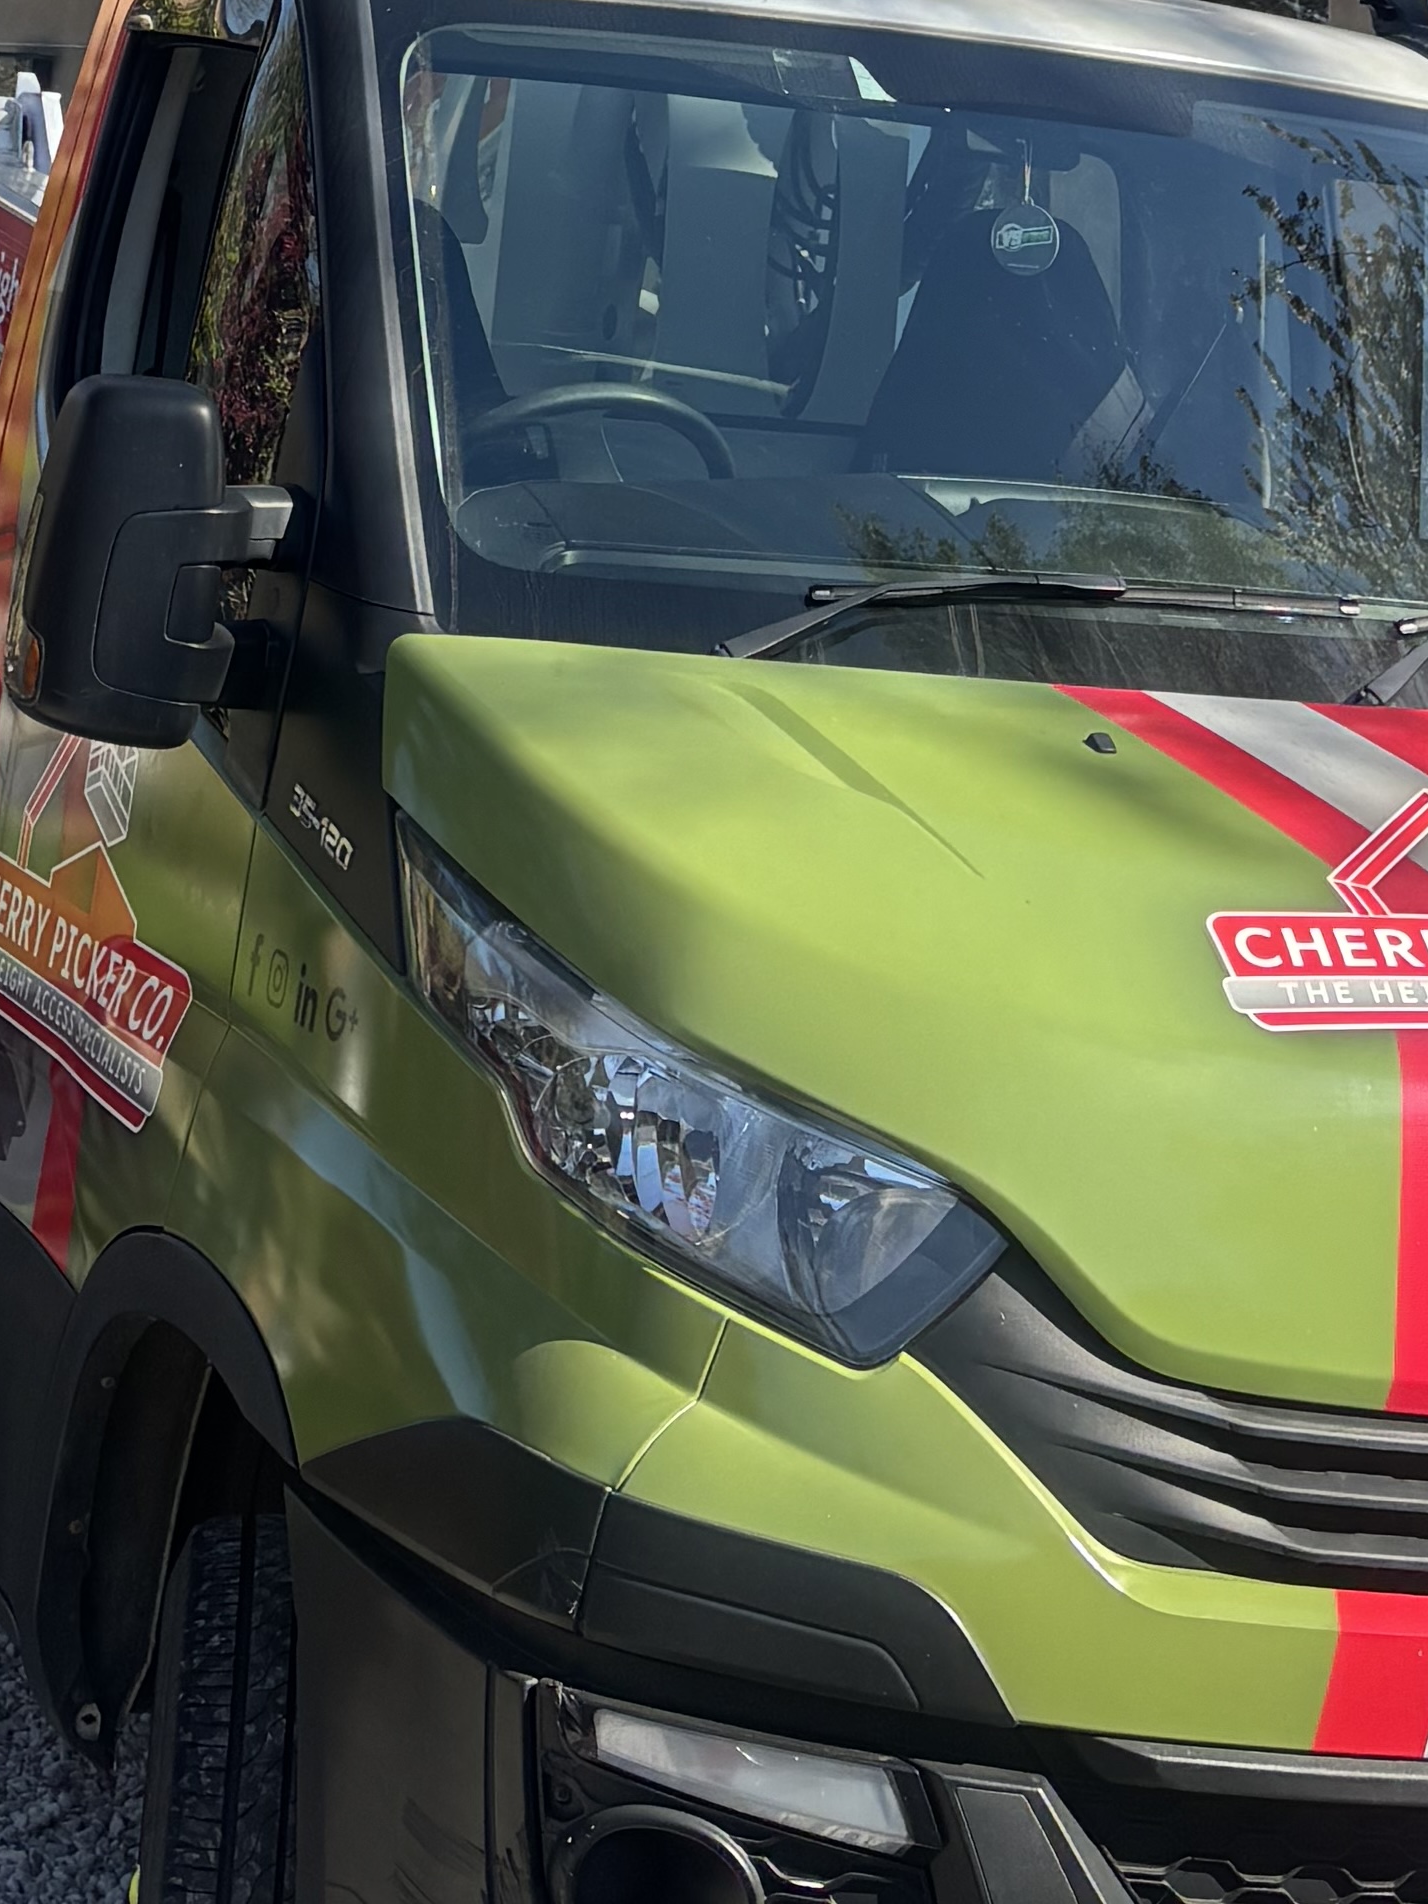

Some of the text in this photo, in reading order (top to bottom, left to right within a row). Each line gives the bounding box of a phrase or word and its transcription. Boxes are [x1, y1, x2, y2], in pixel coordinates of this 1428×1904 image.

[48, 916, 138, 1018] PICKER
[127, 975, 175, 1049] CO.
[1278, 981, 1355, 1004] THE
[32, 986, 77, 1037] ACCESS
[71, 1018, 147, 1095] SPECIALISTS
